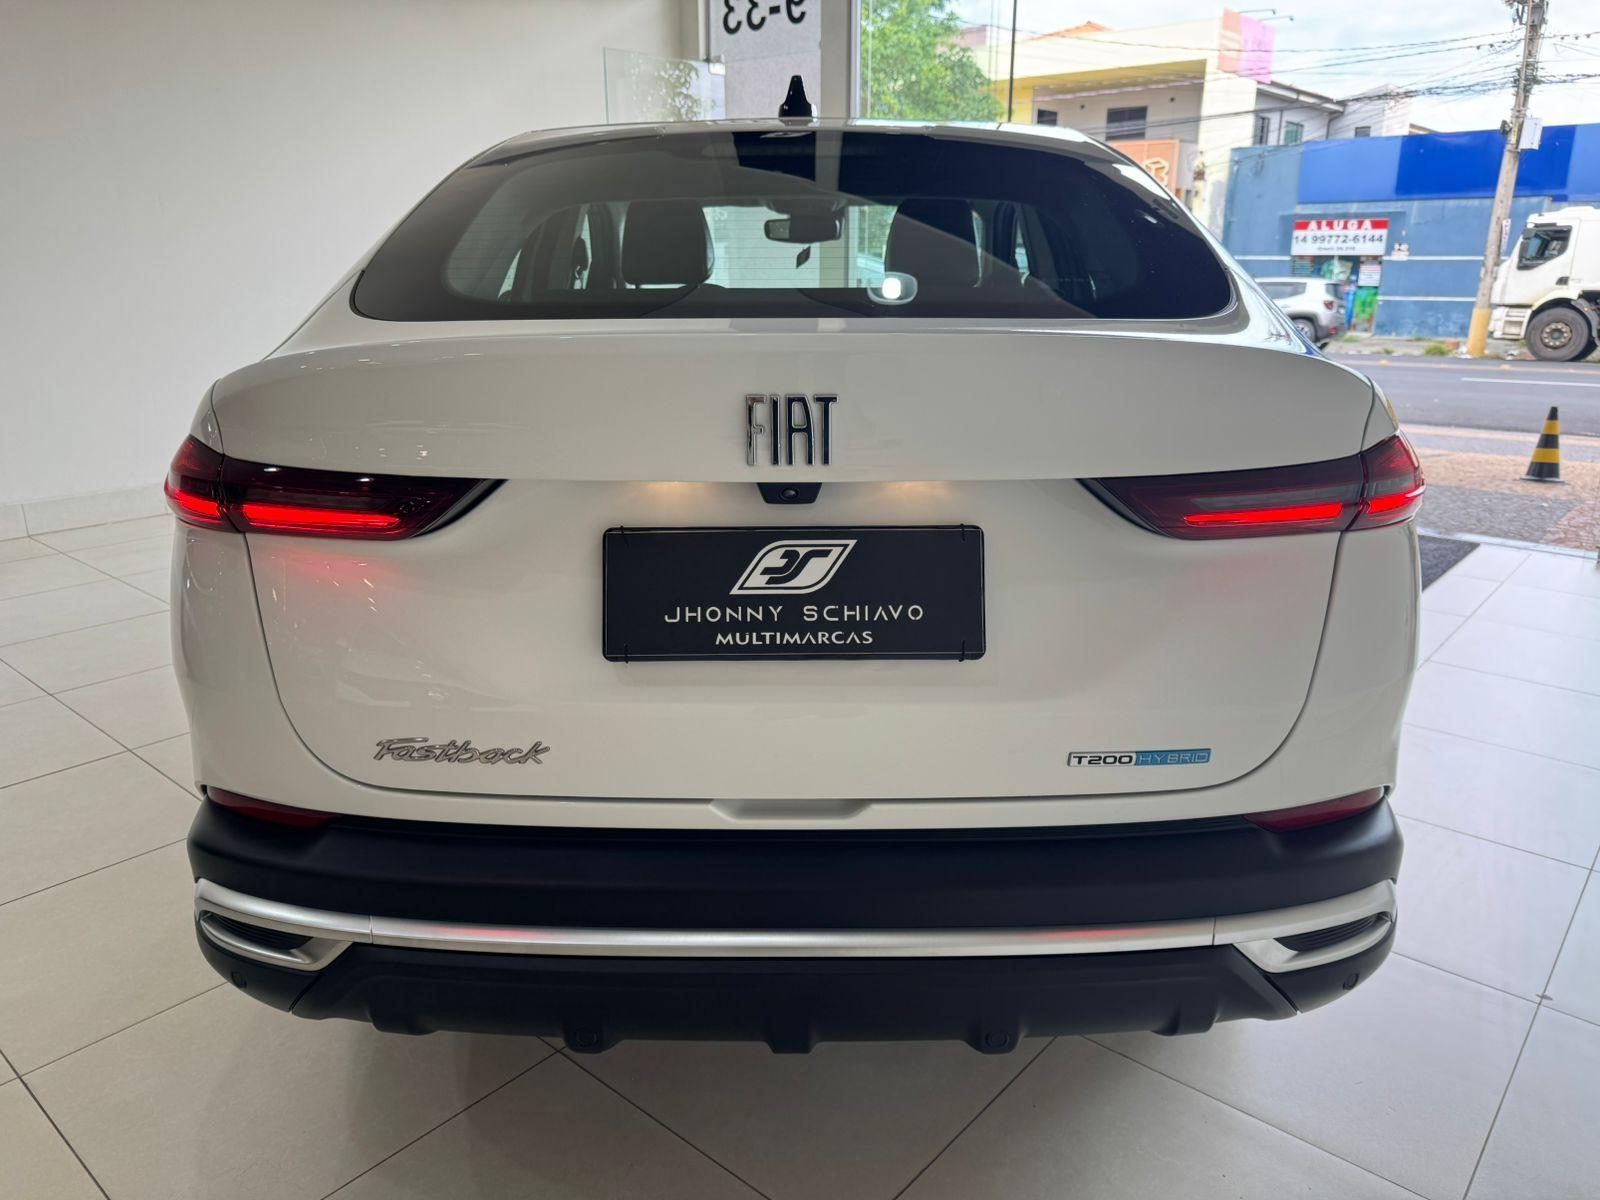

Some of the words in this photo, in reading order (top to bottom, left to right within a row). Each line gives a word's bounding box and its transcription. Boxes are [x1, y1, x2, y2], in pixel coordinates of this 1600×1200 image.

[1307, 219, 1373, 231] ALUGA
[1294, 234, 1307, 244] 14
[1311, 234, 1384, 244] 99772-6144
[746, 394, 839, 465] FIAT
[664, 606, 783, 623] JHONNY
[803, 604, 924, 622] SCHIAVO
[715, 631, 873, 645] MULTIMARCAS
[373, 737, 551, 765] Fastback
